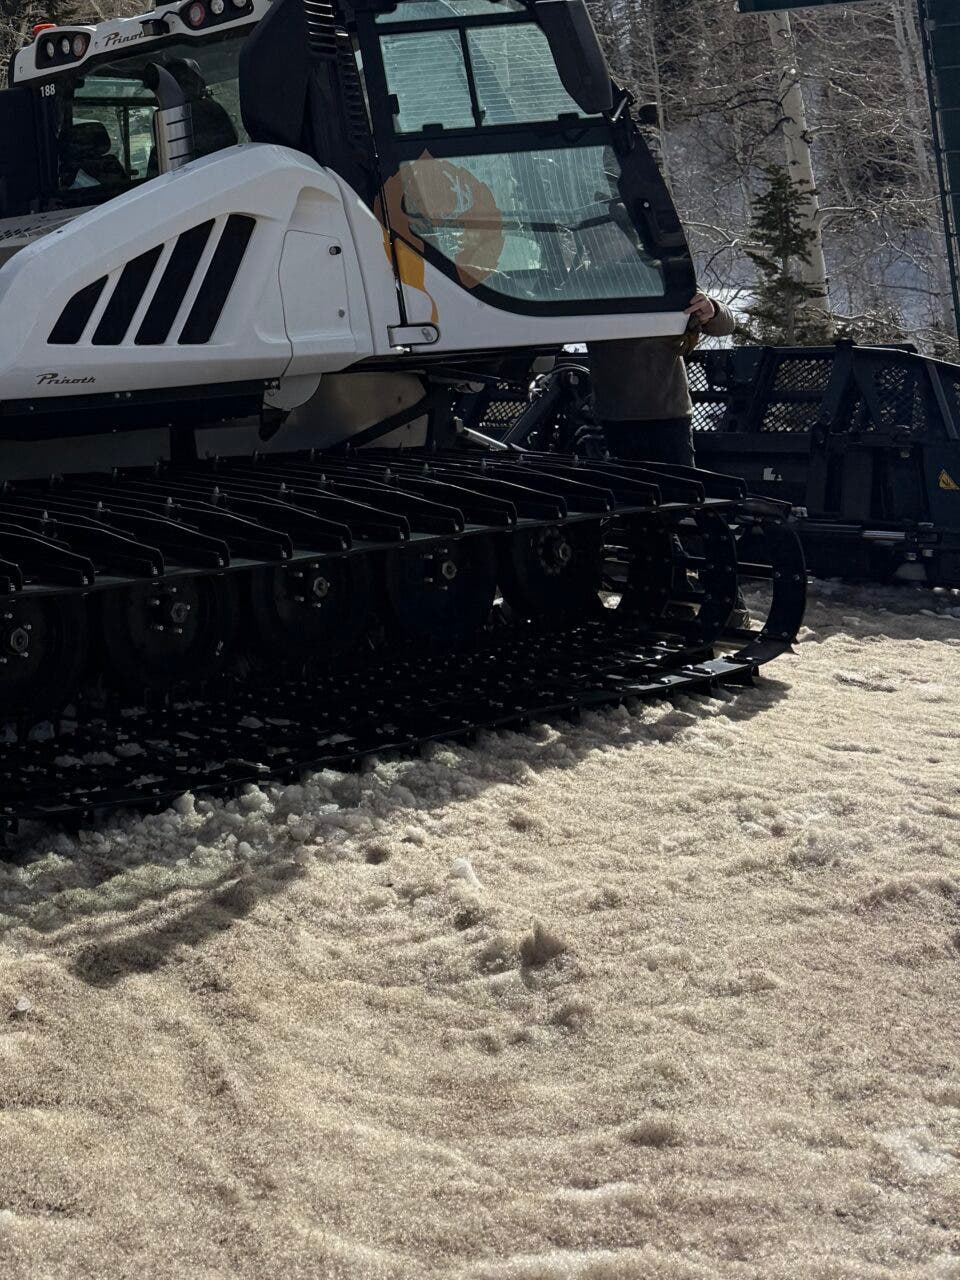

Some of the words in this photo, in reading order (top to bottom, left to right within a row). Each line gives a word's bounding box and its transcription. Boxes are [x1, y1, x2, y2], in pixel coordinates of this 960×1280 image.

[102, 31, 145, 47] Prinot
[40, 83, 56, 98] 188
[35, 372, 96, 385] Prinoth
